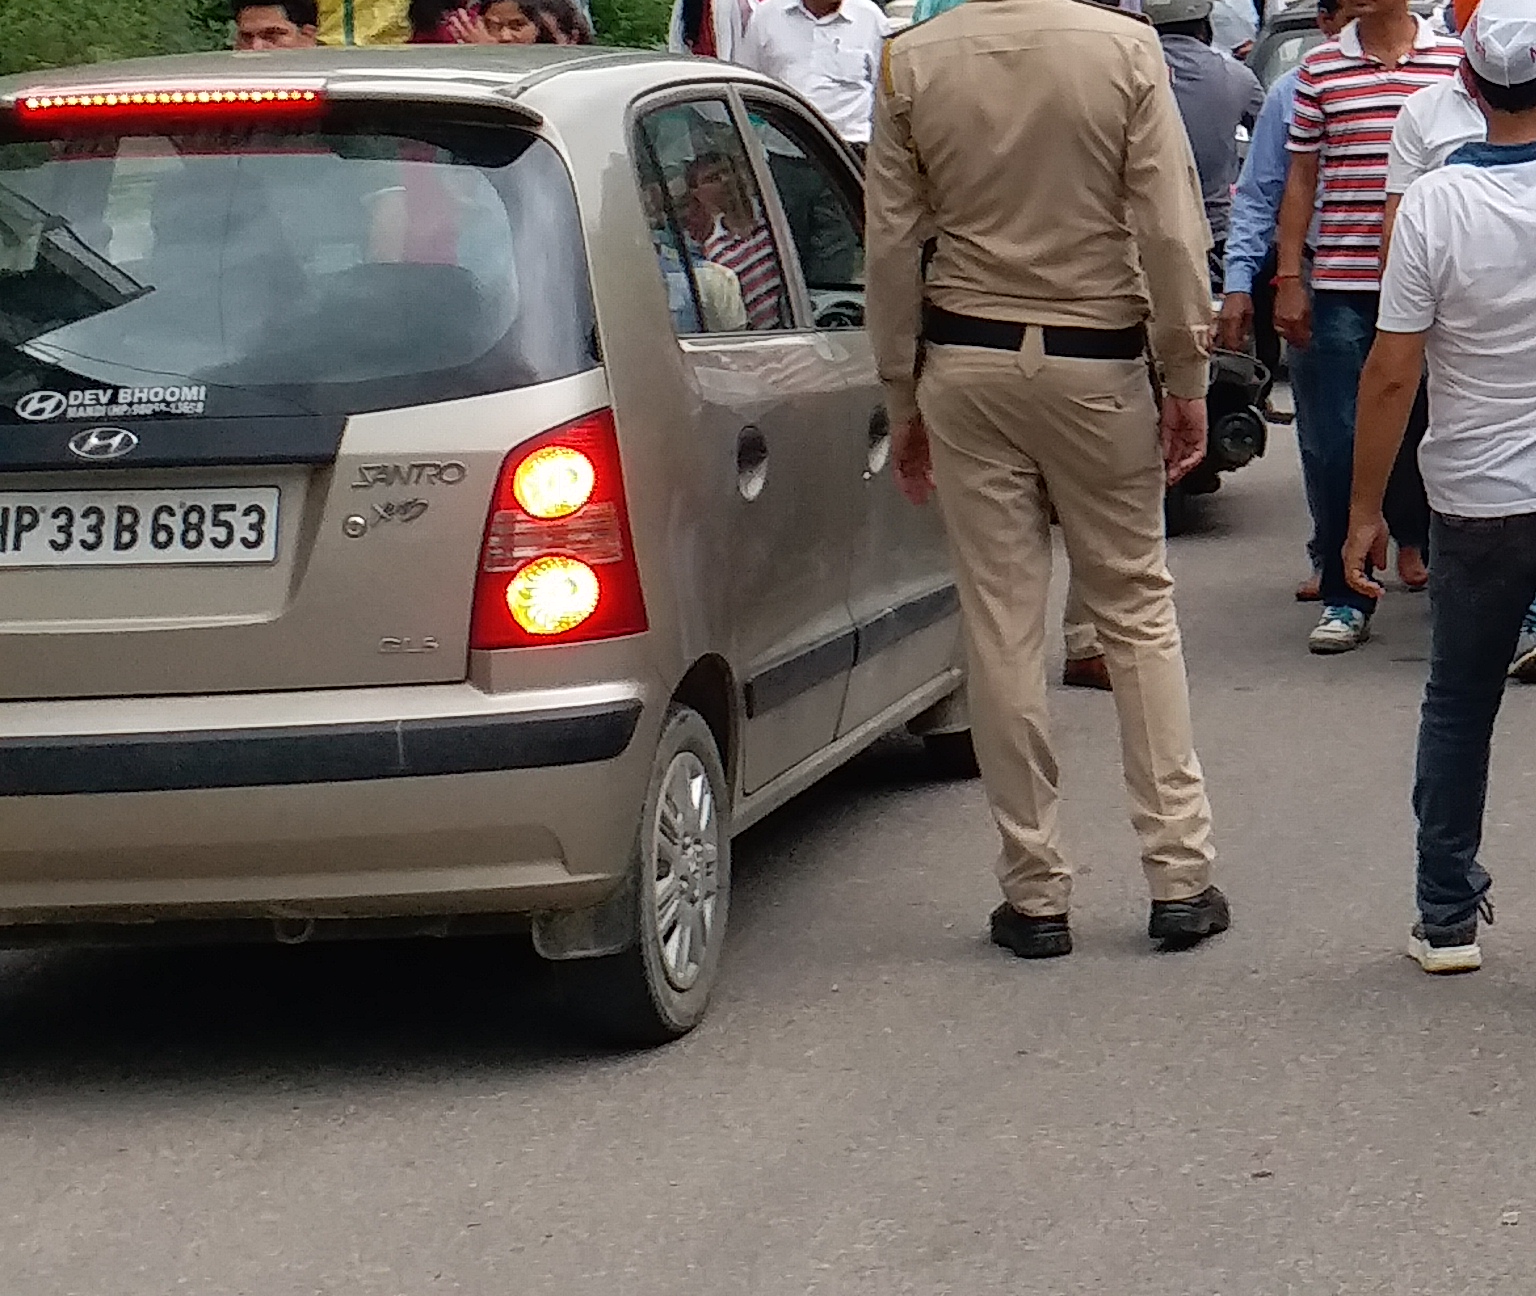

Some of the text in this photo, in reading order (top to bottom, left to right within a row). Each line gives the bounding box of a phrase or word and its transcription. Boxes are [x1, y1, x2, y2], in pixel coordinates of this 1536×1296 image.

[69, 385, 207, 405] DEV BHOOMI
[350, 460, 467, 489] SANTRO
[49, 505, 105, 552] 33
[114, 505, 140, 552] B
[150, 503, 267, 551] 6853
